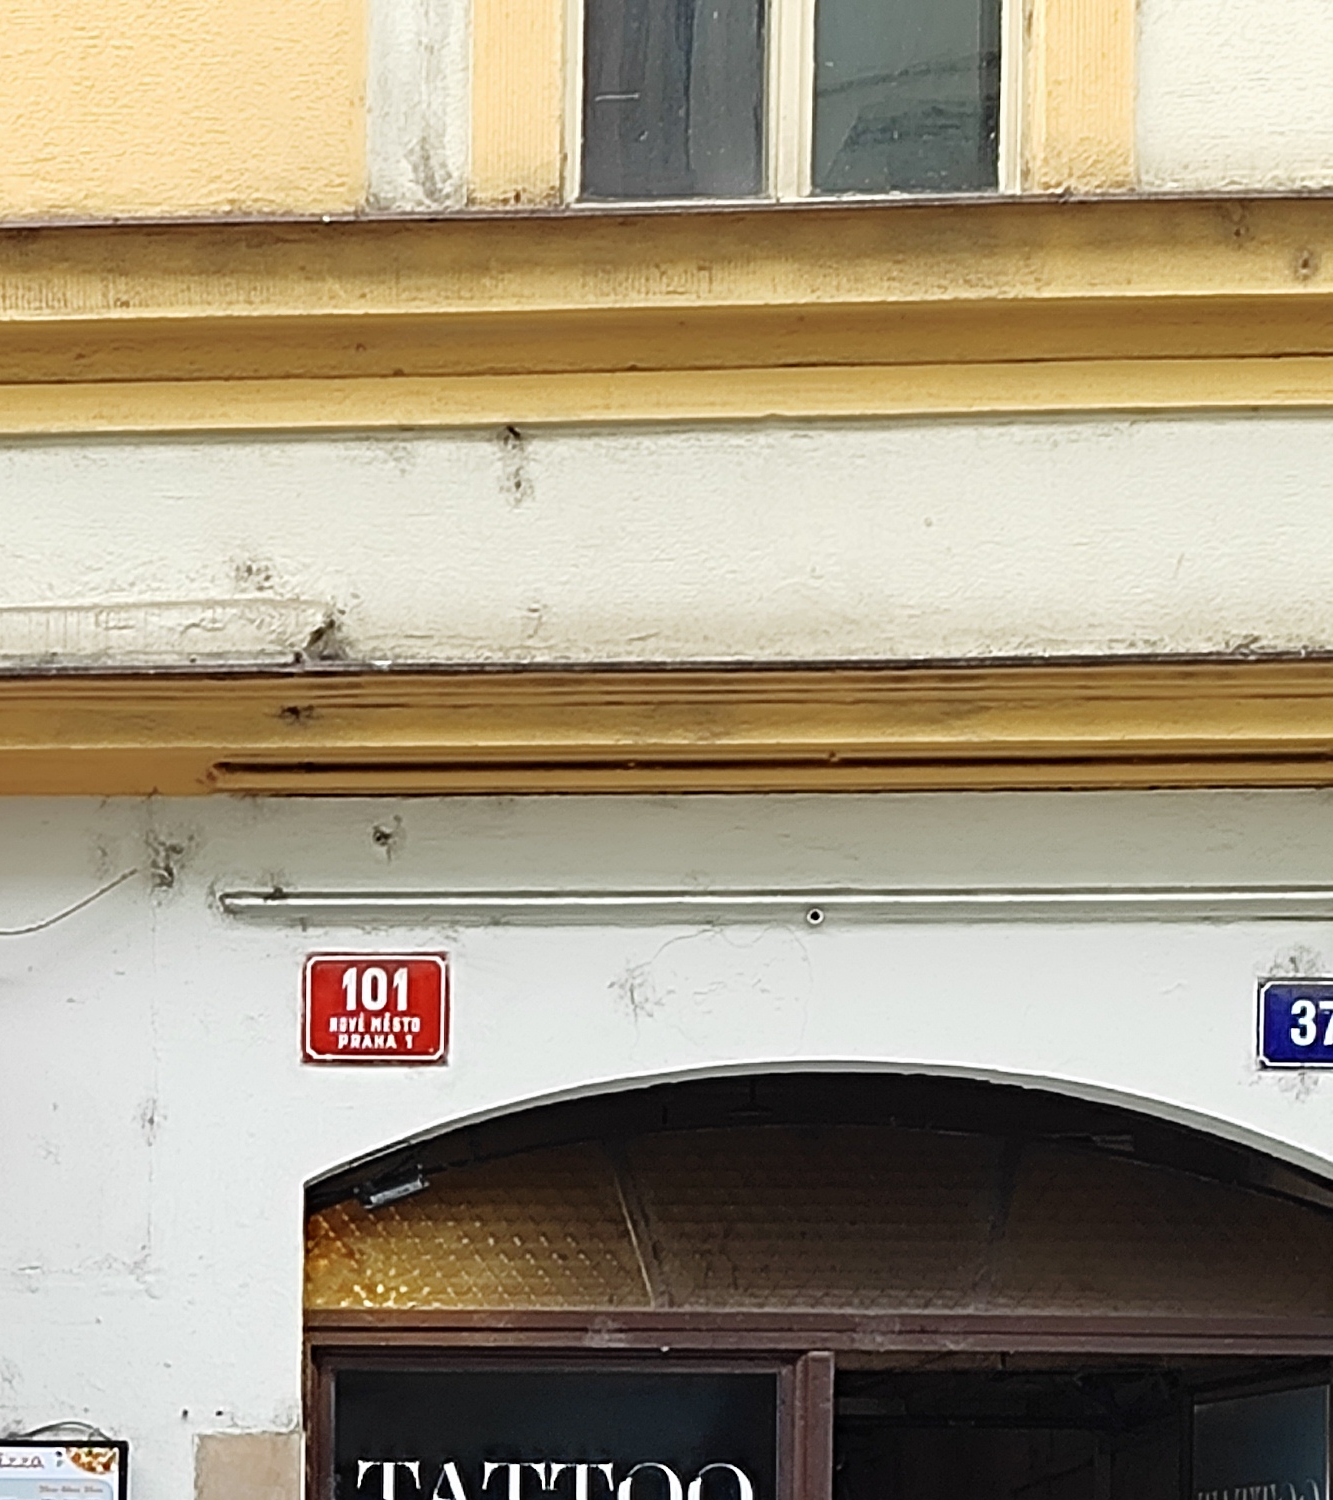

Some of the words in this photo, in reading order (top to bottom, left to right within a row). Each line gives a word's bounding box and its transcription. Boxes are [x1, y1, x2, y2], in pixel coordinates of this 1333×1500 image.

[341, 966, 409, 1012] 101
[329, 1012, 366, 1033] NOVÉ
[370, 1012, 421, 1033] MĚSTO
[1290, 999, 1333, 1046] 37
[337, 1034, 398, 1050] PRAHA
[405, 1034, 414, 1050] 1
